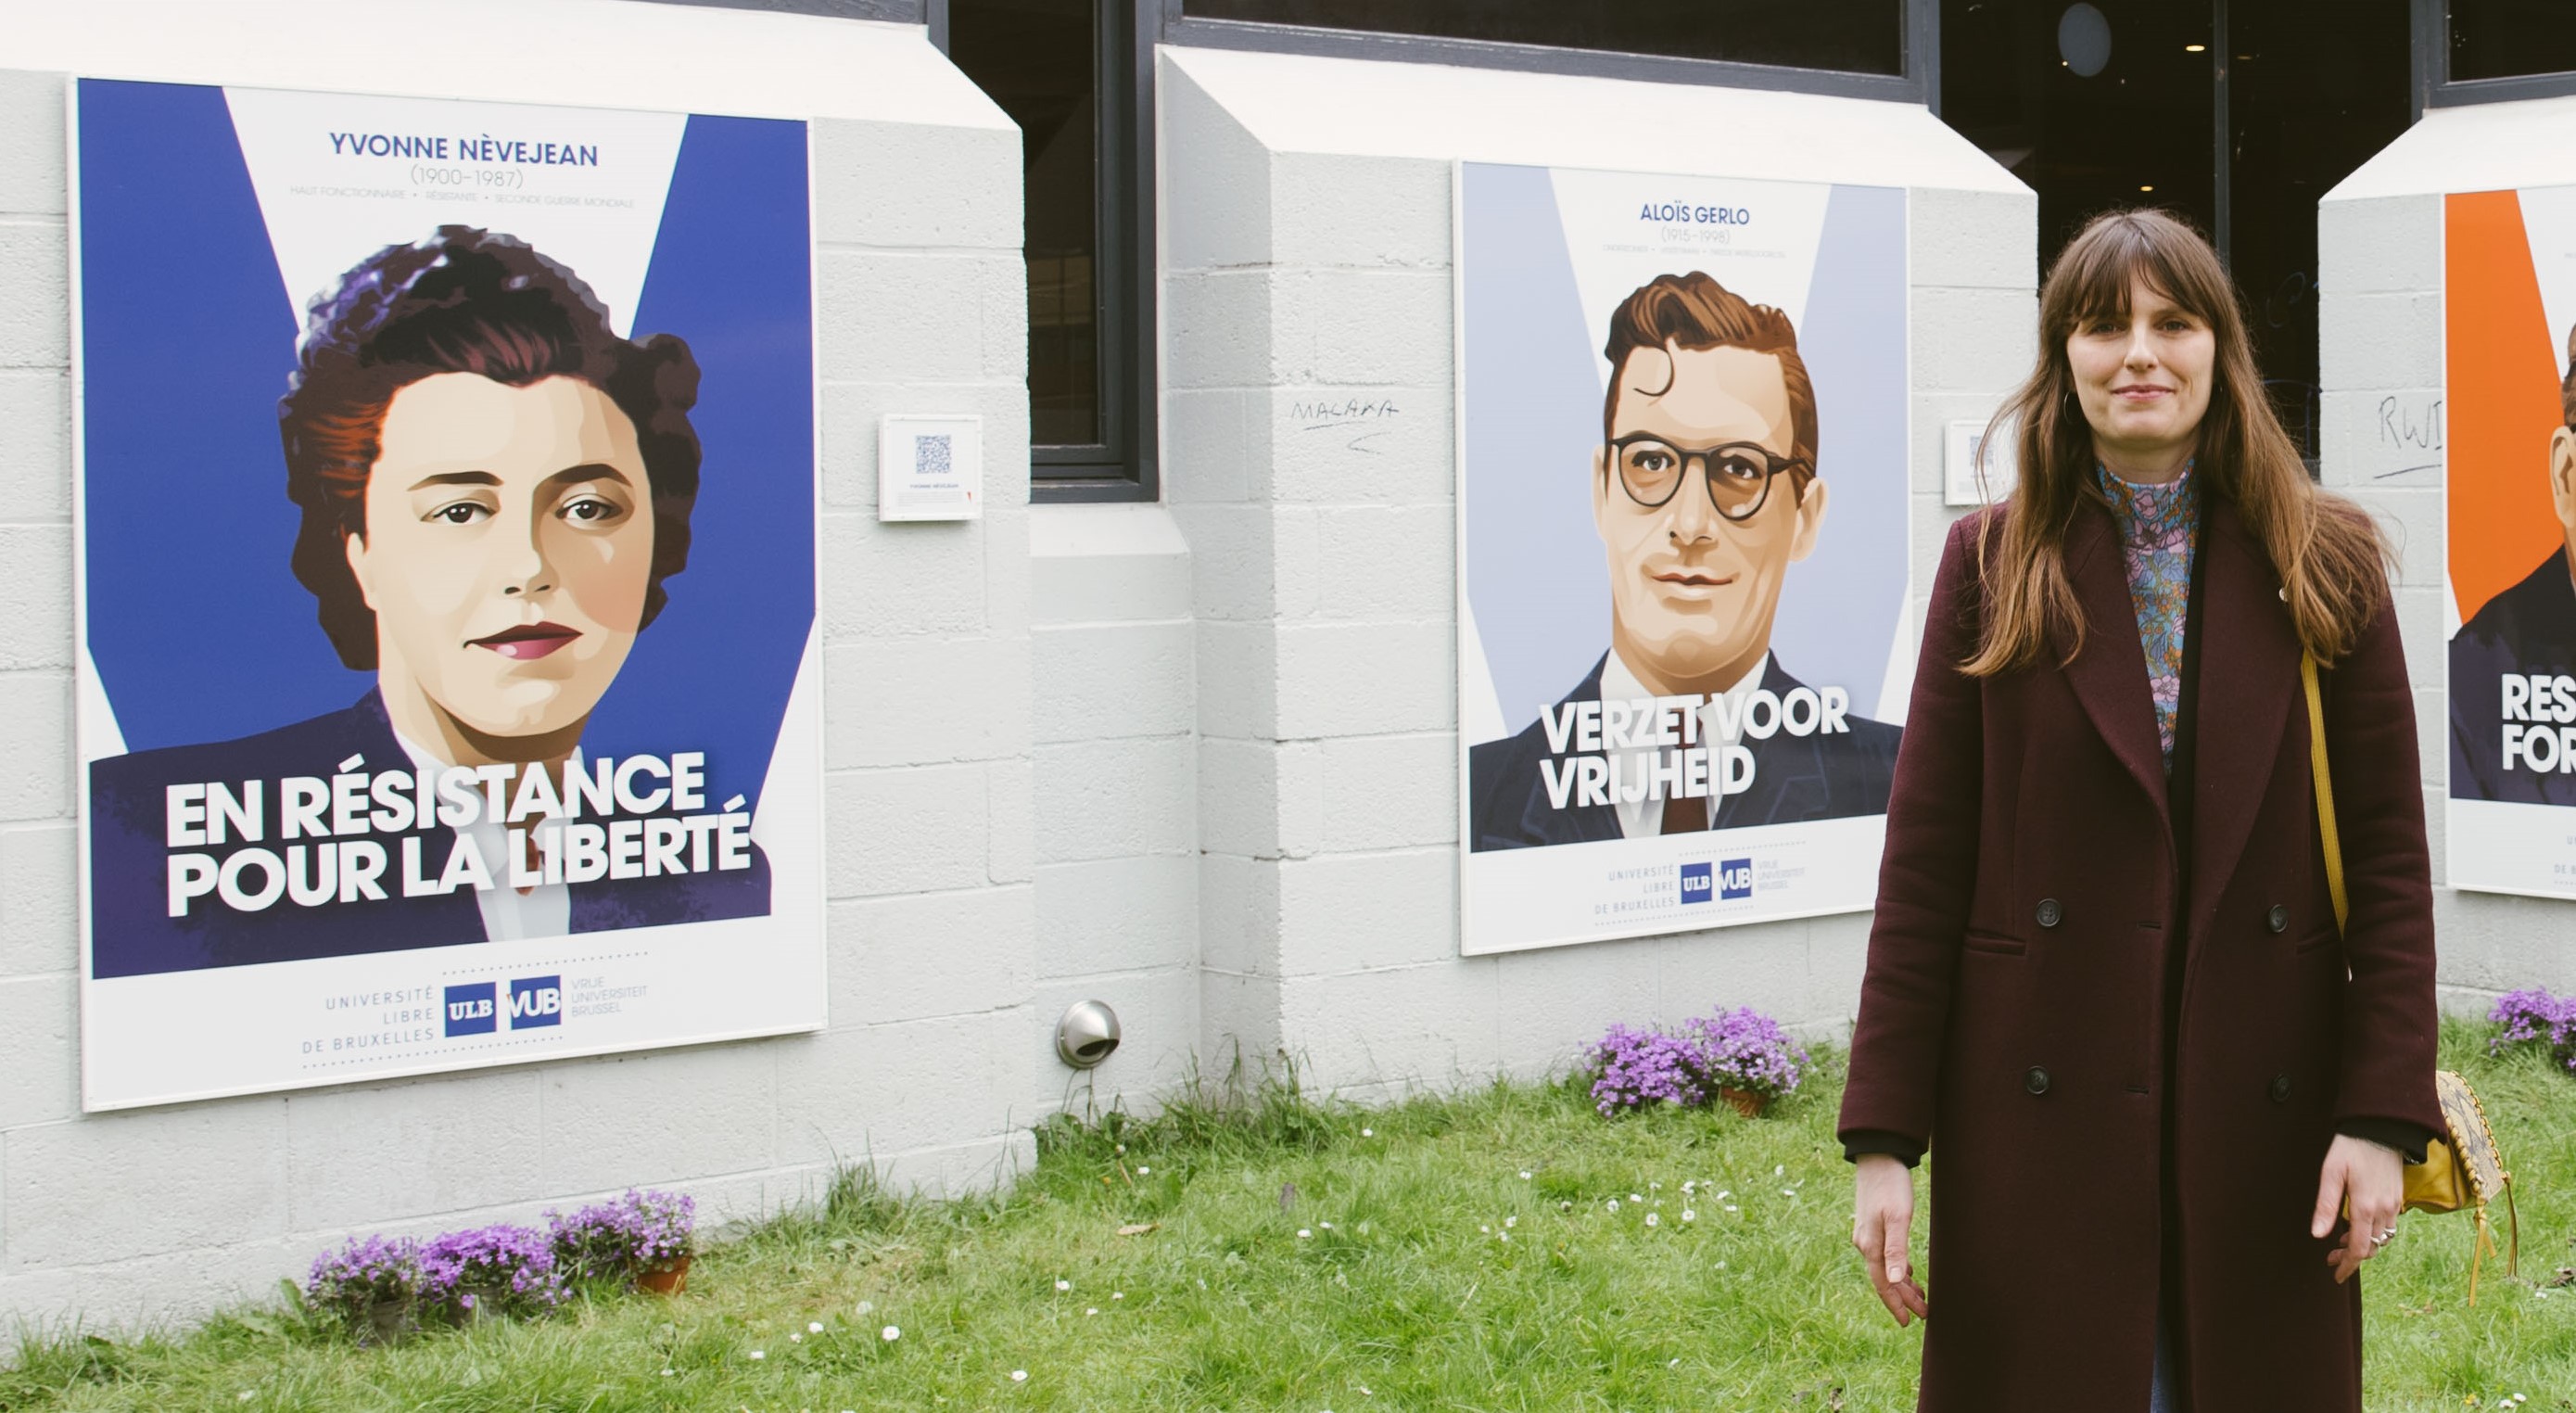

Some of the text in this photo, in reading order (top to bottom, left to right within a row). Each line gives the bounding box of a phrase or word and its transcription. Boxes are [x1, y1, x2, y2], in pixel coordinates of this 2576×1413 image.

[329, 132, 598, 167] YVONNE NÈVEJEAN
[1641, 199, 1750, 225] ALOÏS GERLO
[2501, 673, 2576, 723] RES
[1539, 686, 1850, 755] VERZET VOOR
[1539, 745, 1757, 810] VRIJHEID
[167, 752, 705, 847] EN RÉSISTANCE
[167, 794, 751, 918] POUR LA LIBERTÉ
[1643, 881, 1675, 894] LIBRE
[1682, 867, 1751, 892] ULB VUB
[1594, 897, 1675, 915] DE BRUXELLES
[570, 975, 604, 990] VRIJE
[325, 986, 435, 1011] UNIVERSITÉ
[449, 987, 562, 1021] ULB VUB
[570, 1001, 622, 1018] BRUSSEL
[382, 1007, 435, 1026] LIBRE
[301, 1028, 435, 1055] DE BRUXELLES
